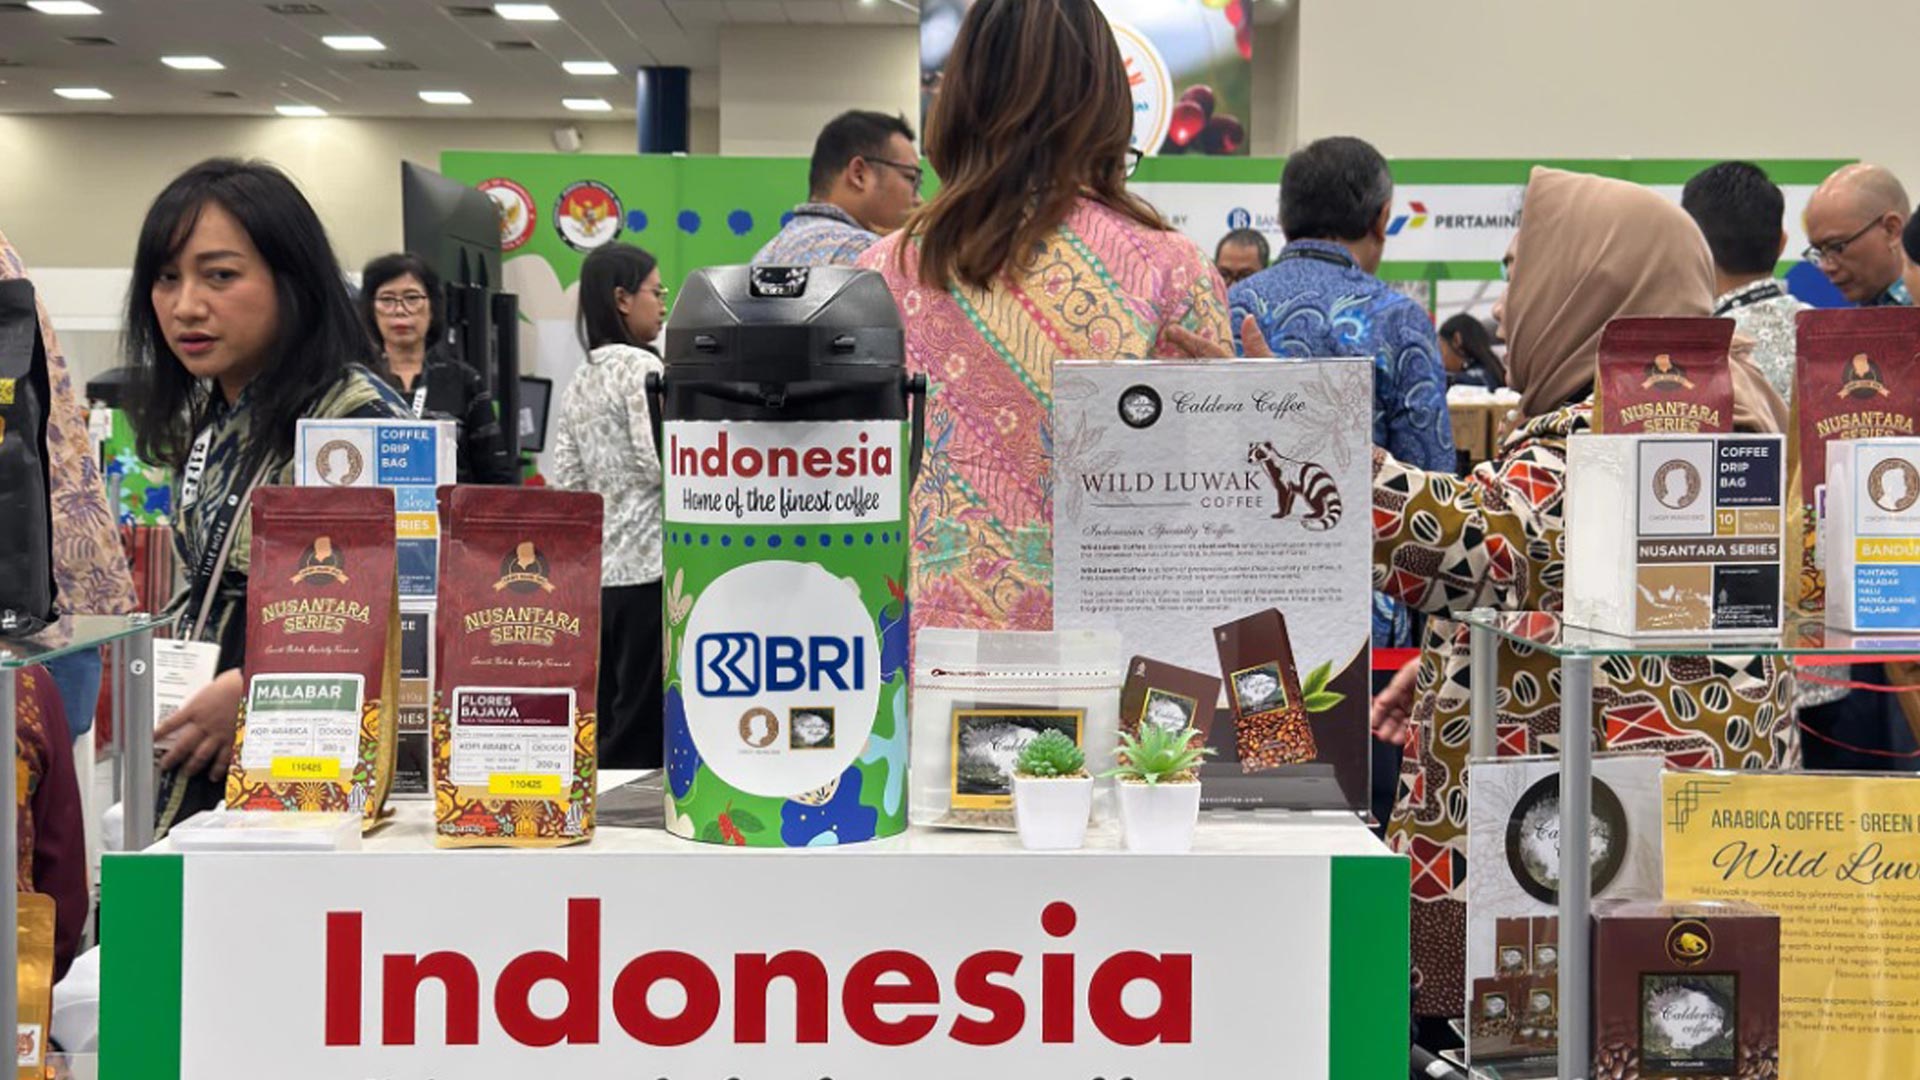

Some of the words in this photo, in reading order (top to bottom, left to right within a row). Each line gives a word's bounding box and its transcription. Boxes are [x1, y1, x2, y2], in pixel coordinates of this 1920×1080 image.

[1256, 215, 1280, 226] BAN
[1172, 391, 1244, 414] Caldera
[1252, 390, 1306, 419] Coffee
[1620, 401, 1720, 428] NUSANTARA
[1642, 417, 1701, 433] SERIES
[1817, 411, 1914, 439] NUSANTARA
[381, 429, 429, 440] COFFEE
[381, 443, 410, 454] DRIP
[671, 431, 892, 478] Indonesia
[1720, 447, 1769, 457] COFFEE
[381, 458, 408, 468] BAG
[1720, 462, 1749, 473] DRIP
[1082, 472, 1155, 494] WILD
[1165, 471, 1262, 492] LUWAK
[1720, 478, 1747, 488] BAG
[683, 488, 722, 512] Home
[725, 488, 743, 518] of
[747, 487, 776, 512] the
[779, 487, 832, 518] finest
[836, 486, 880, 518] coffee
[1201, 496, 1263, 509] COFFEE
[1719, 513, 1734, 526] 10
[1639, 544, 1726, 558] NUSANTARA
[1729, 543, 1777, 556] SERIES
[262, 597, 371, 625] NUSANTARA
[283, 614, 347, 634] SERIES
[464, 606, 581, 637] NUSANTARA
[490, 625, 557, 646] SERIES
[765, 635, 865, 691] BRI
[256, 684, 342, 699] MALABAR
[461, 695, 512, 706] FLORES
[461, 707, 520, 718] BAJAWA
[482, 744, 521, 753] ARABICA
[990, 736, 1028, 751] Cald
[535, 760, 552, 770] 200
[1711, 808, 1782, 831] ARABICA
[1786, 811, 1844, 832] COFFEE
[1861, 812, 1912, 833] GREEN
[1712, 840, 1828, 881] Wild
[322, 896, 1193, 1047] Indonesia
